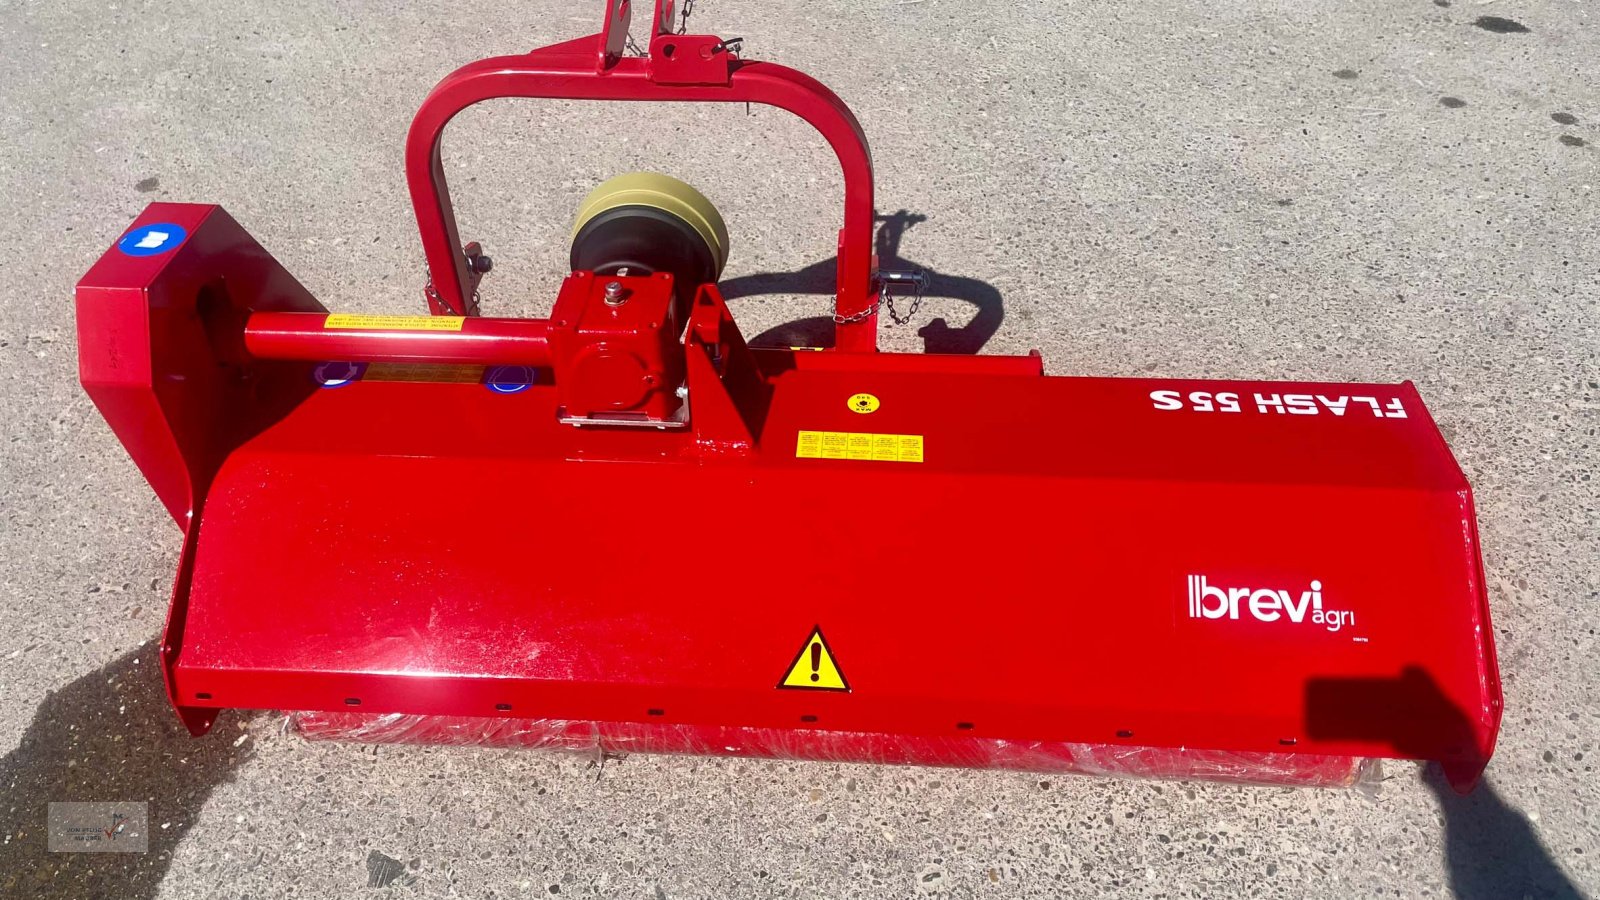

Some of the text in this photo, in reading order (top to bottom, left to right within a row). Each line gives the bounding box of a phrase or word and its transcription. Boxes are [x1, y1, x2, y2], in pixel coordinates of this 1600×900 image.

[1149, 390, 1408, 419] FLASH 55 S
[1188, 574, 1322, 623] brevi
